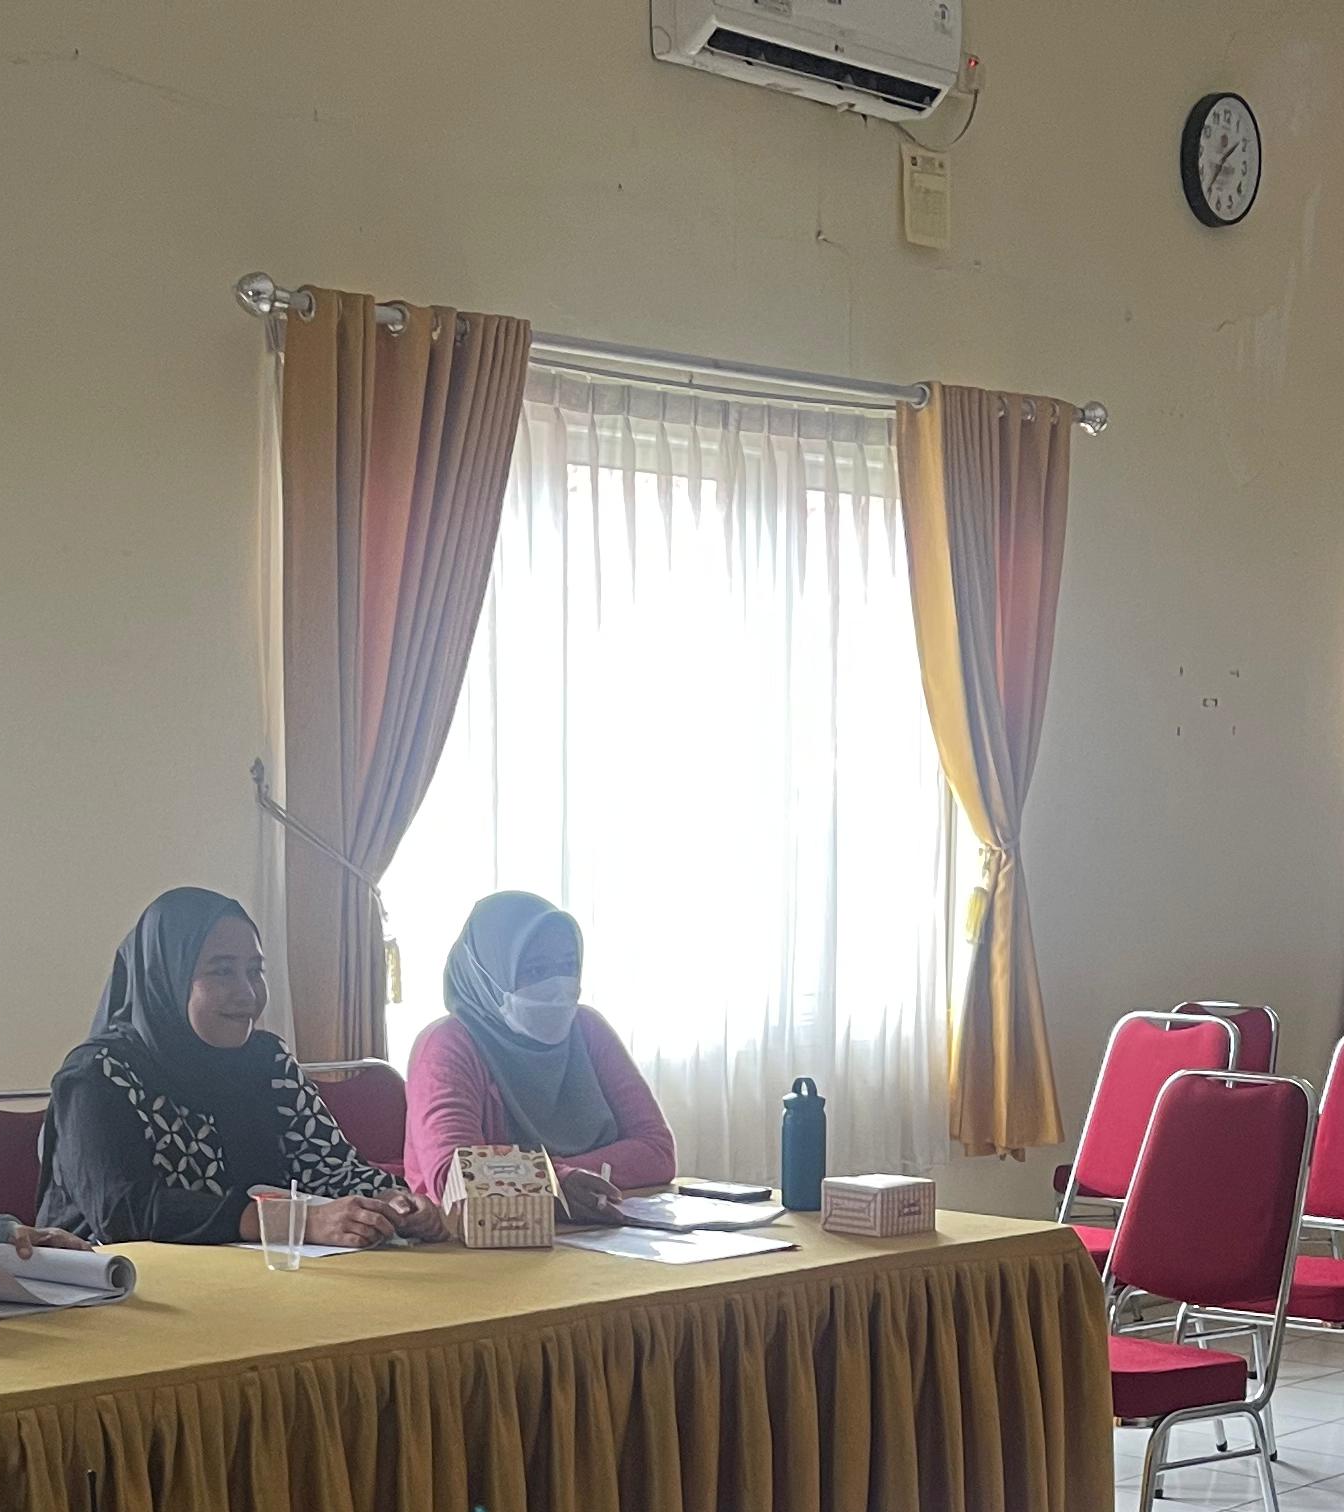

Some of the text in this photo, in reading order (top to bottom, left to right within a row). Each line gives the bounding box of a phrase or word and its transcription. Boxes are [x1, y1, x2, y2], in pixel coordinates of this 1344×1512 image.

[1212, 111, 1220, 125] 11
[1223, 109, 1232, 124] 12
[1241, 160, 1247, 176] 3
